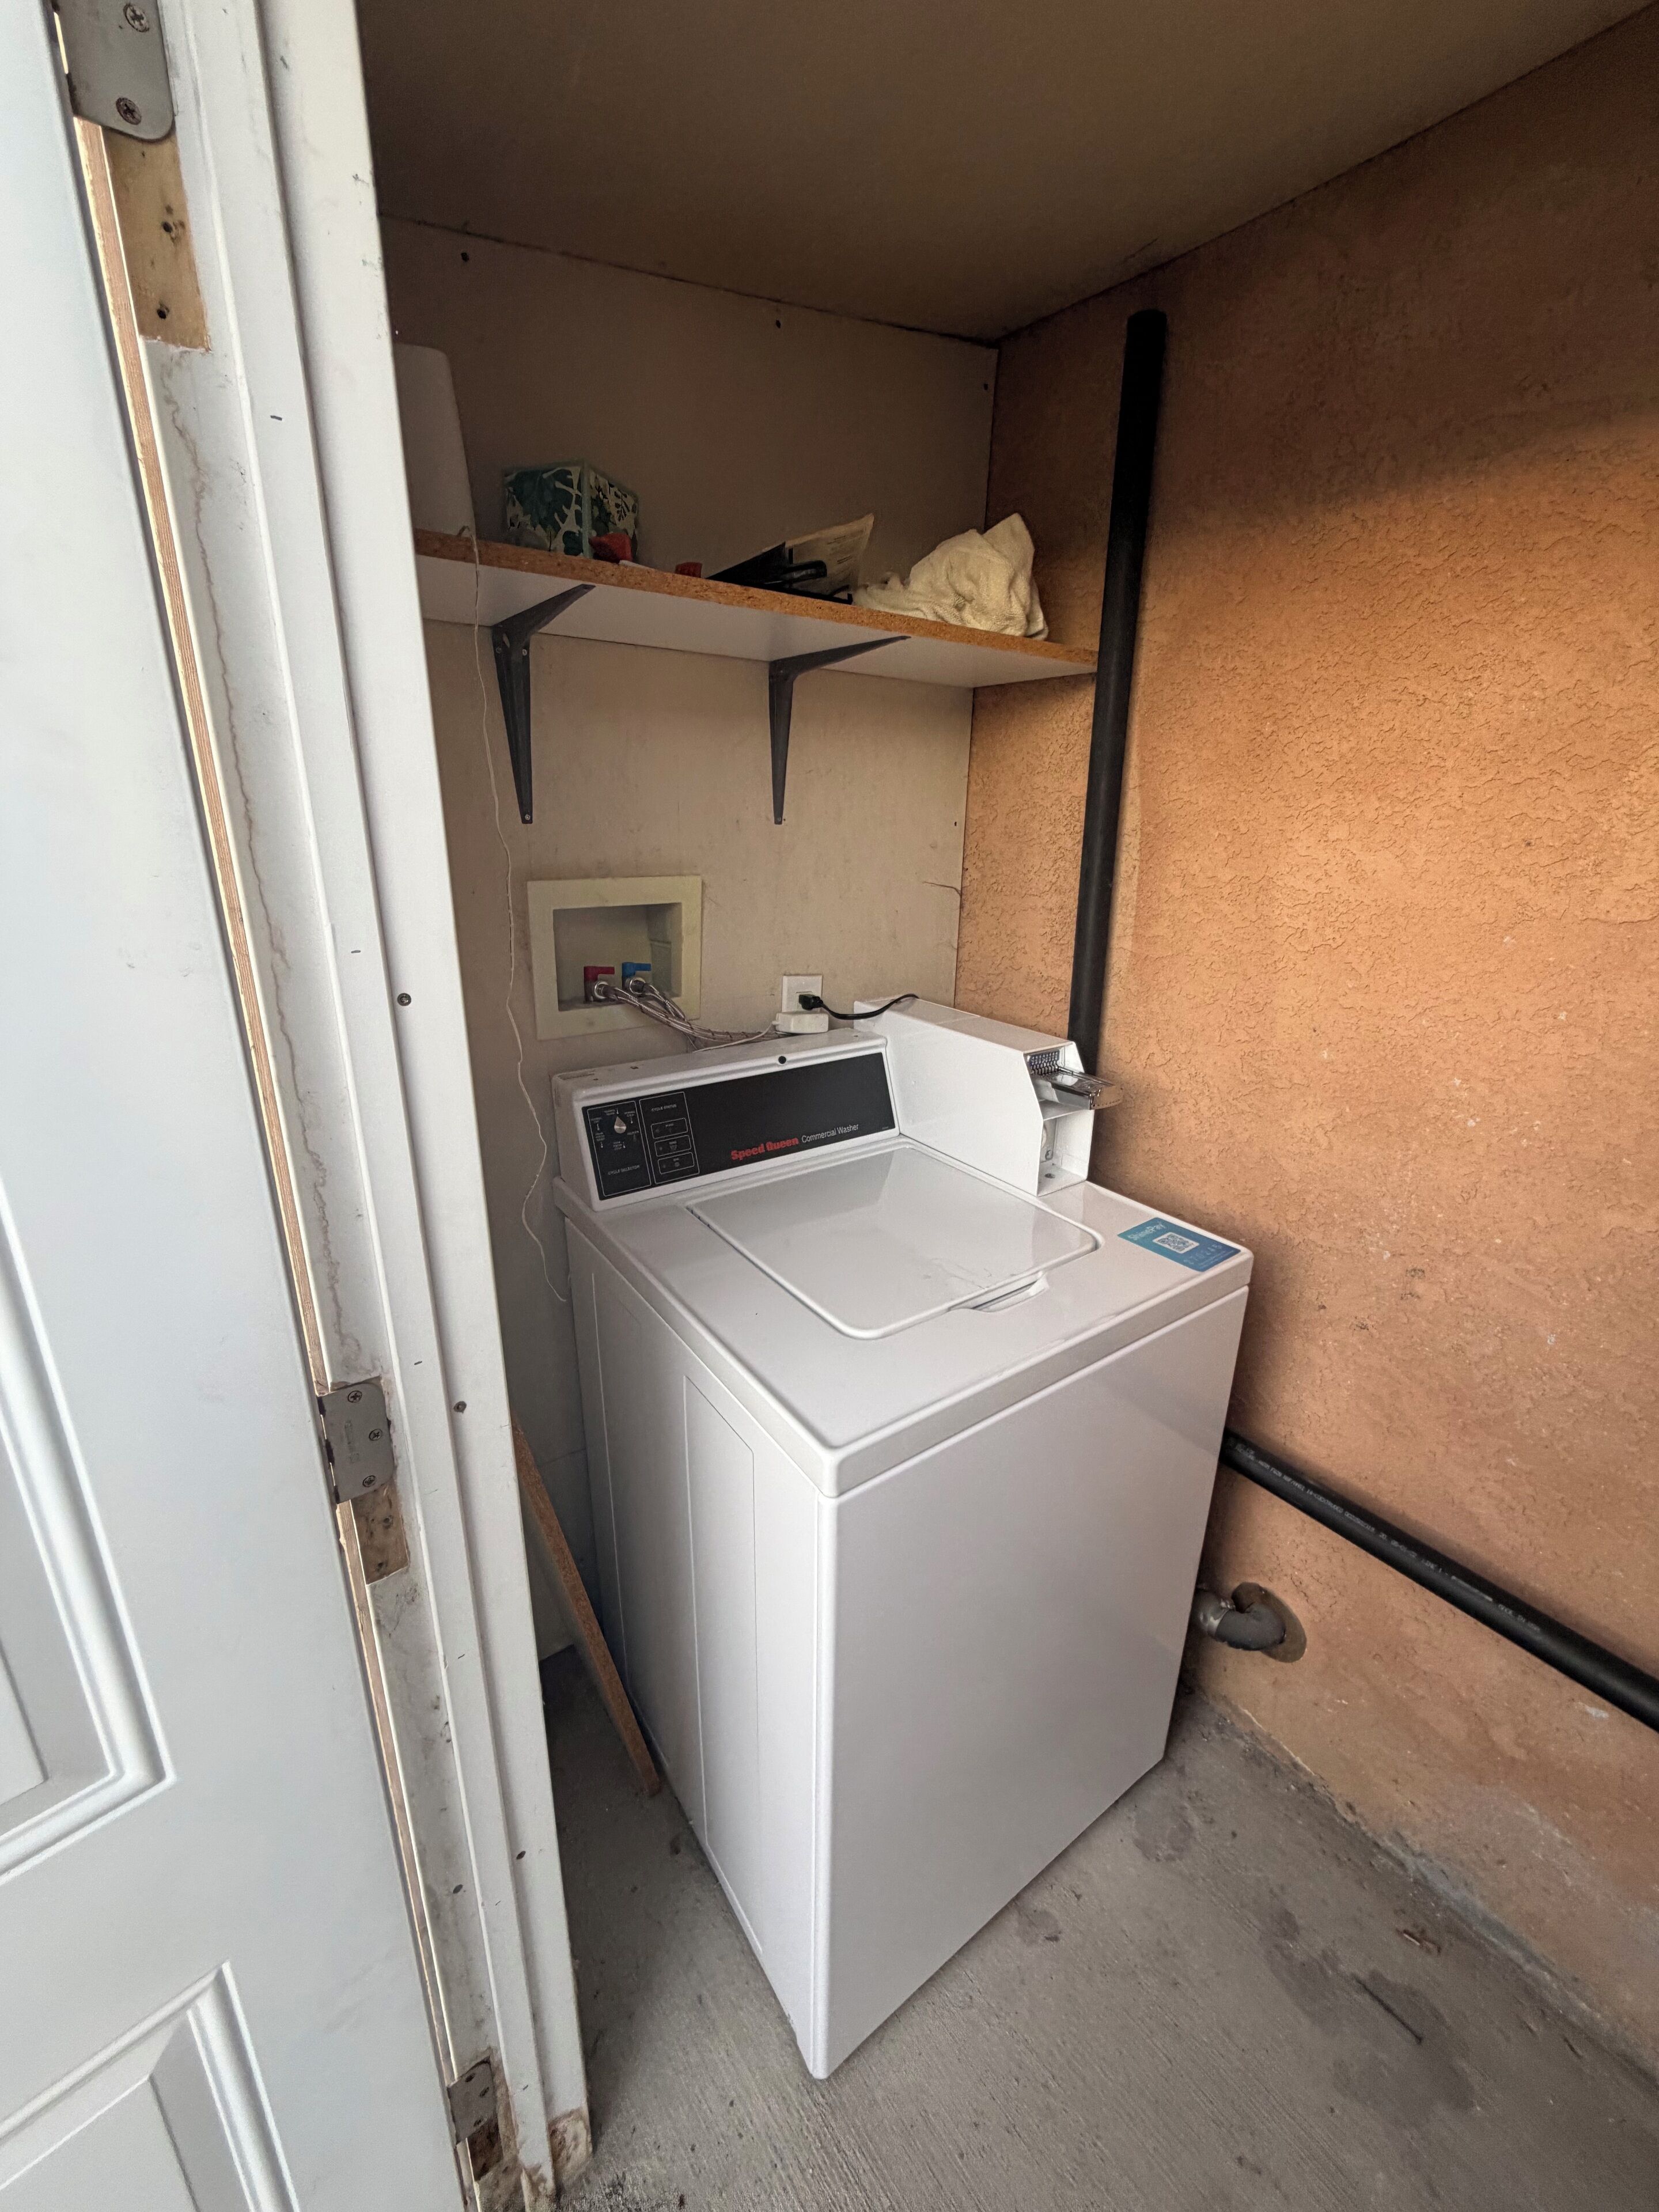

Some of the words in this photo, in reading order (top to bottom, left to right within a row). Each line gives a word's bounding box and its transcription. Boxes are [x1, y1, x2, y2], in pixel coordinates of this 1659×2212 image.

[730, 1143, 765, 1160] Speed
[766, 1138, 800, 1152] Queen
[801, 1126, 836, 1143] Commercial
[836, 1123, 859, 1134] Washer
